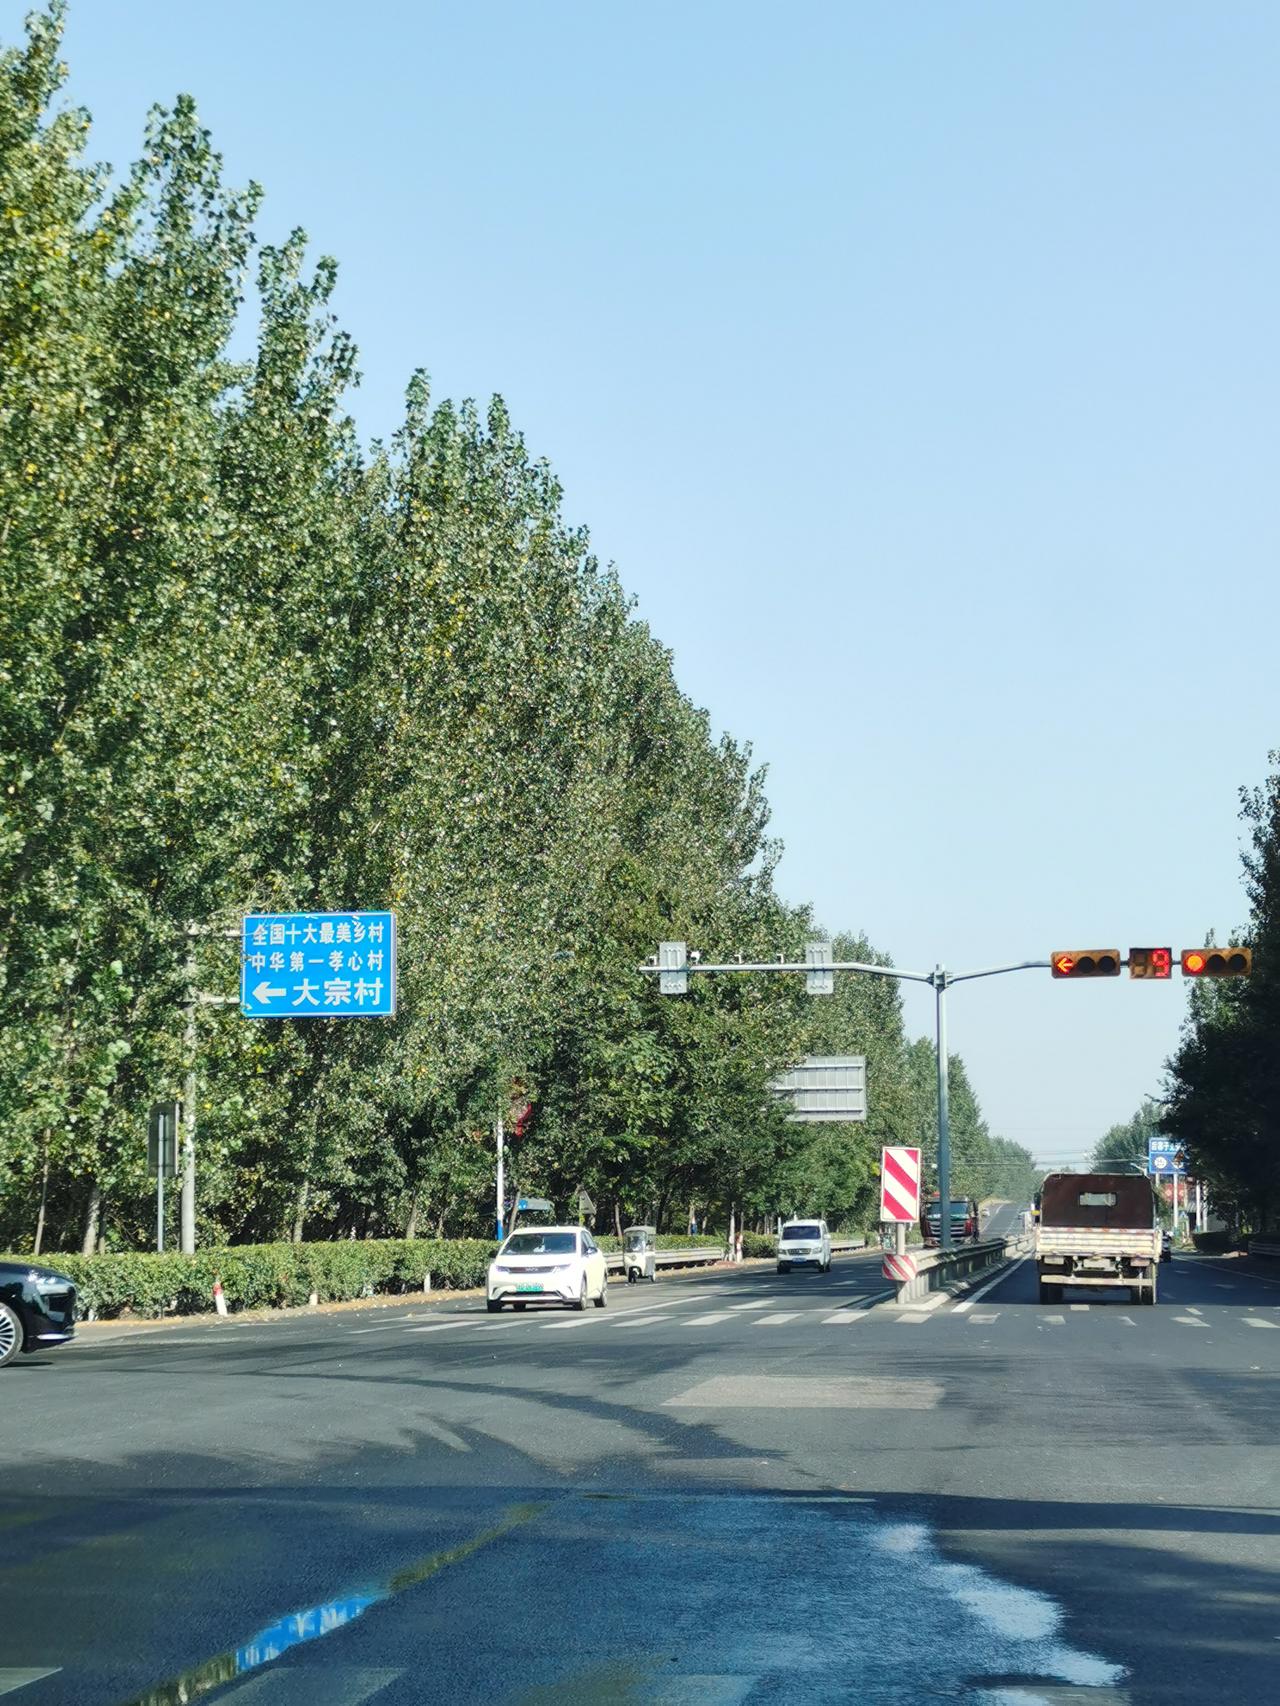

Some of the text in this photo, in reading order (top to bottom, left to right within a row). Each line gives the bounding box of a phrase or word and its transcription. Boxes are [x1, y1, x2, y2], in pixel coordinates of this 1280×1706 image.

[252, 922, 385, 946] 全国十大最美乡村
[251, 949, 384, 974] 中华第一孝心村
[1151, 948, 1170, 977] 9
[291, 977, 384, 1007] 大宗村
